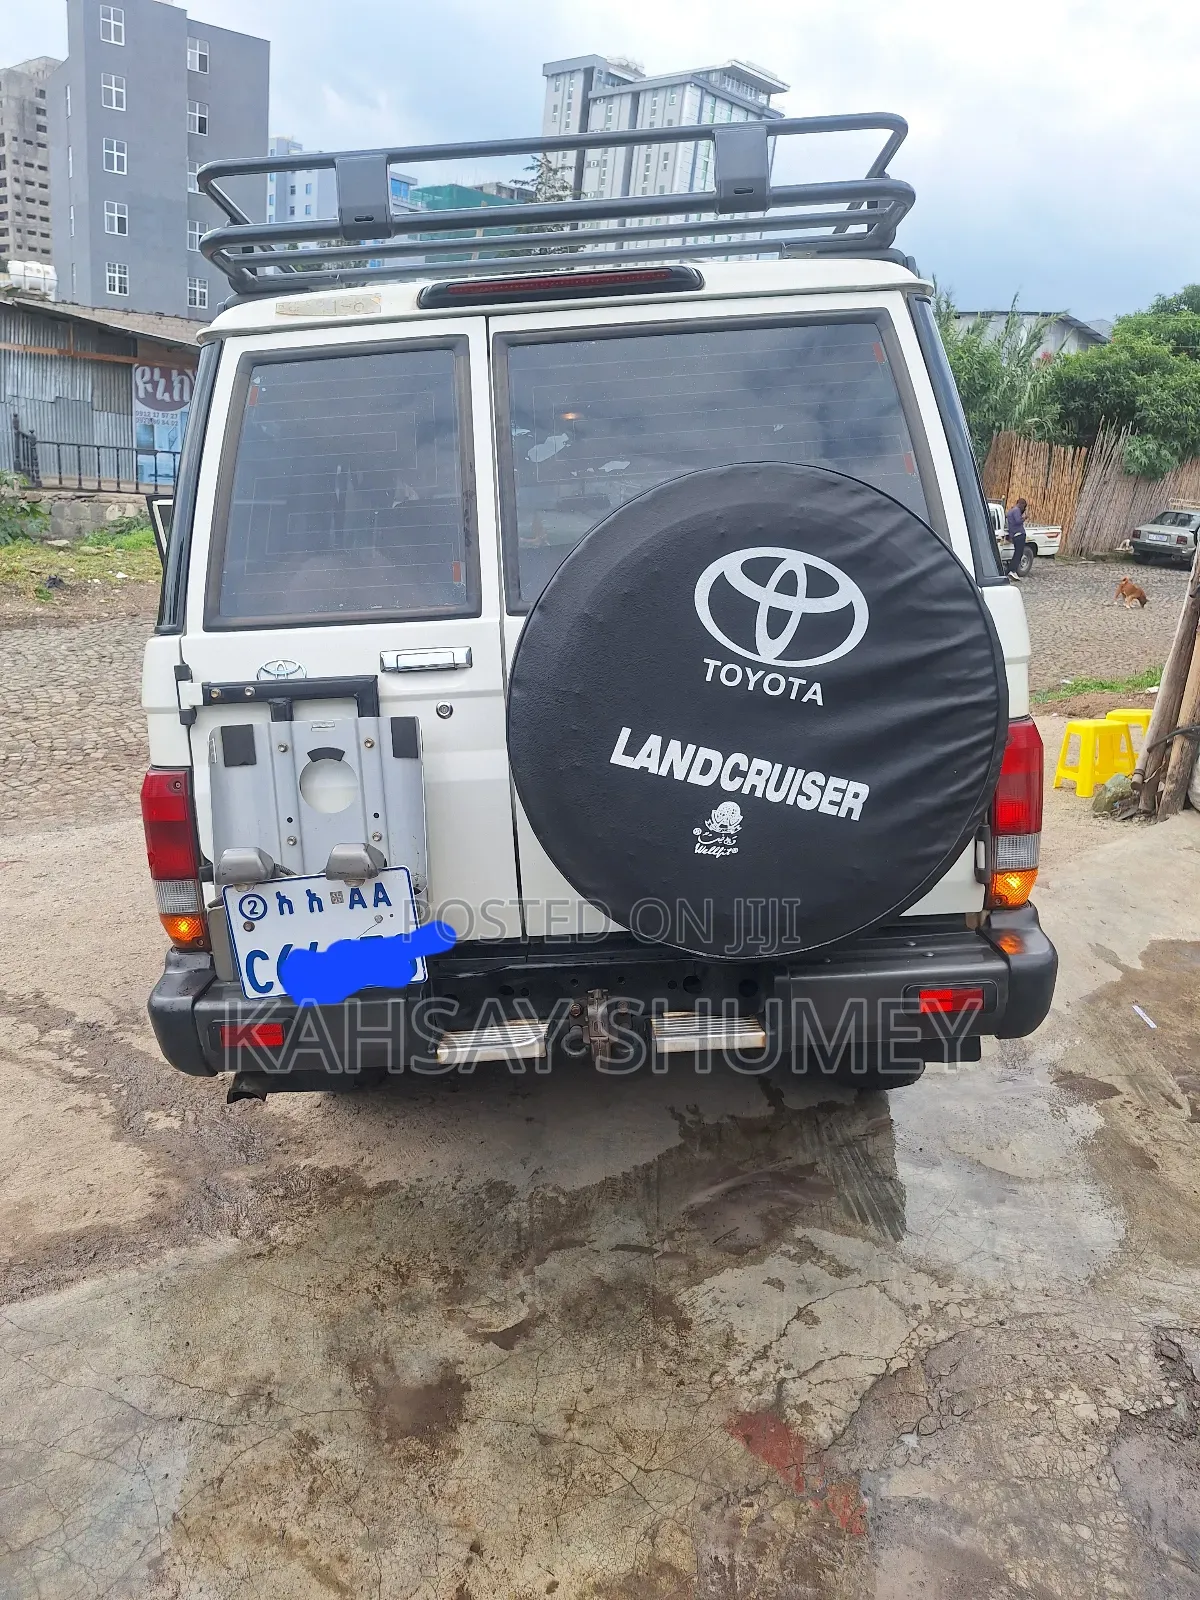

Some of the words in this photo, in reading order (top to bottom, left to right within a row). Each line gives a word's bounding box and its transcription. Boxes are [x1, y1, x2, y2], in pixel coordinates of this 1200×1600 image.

[703, 658, 824, 706] TOYOTA
[609, 726, 870, 821] LANDCRUISER
[349, 882, 392, 910] AA
